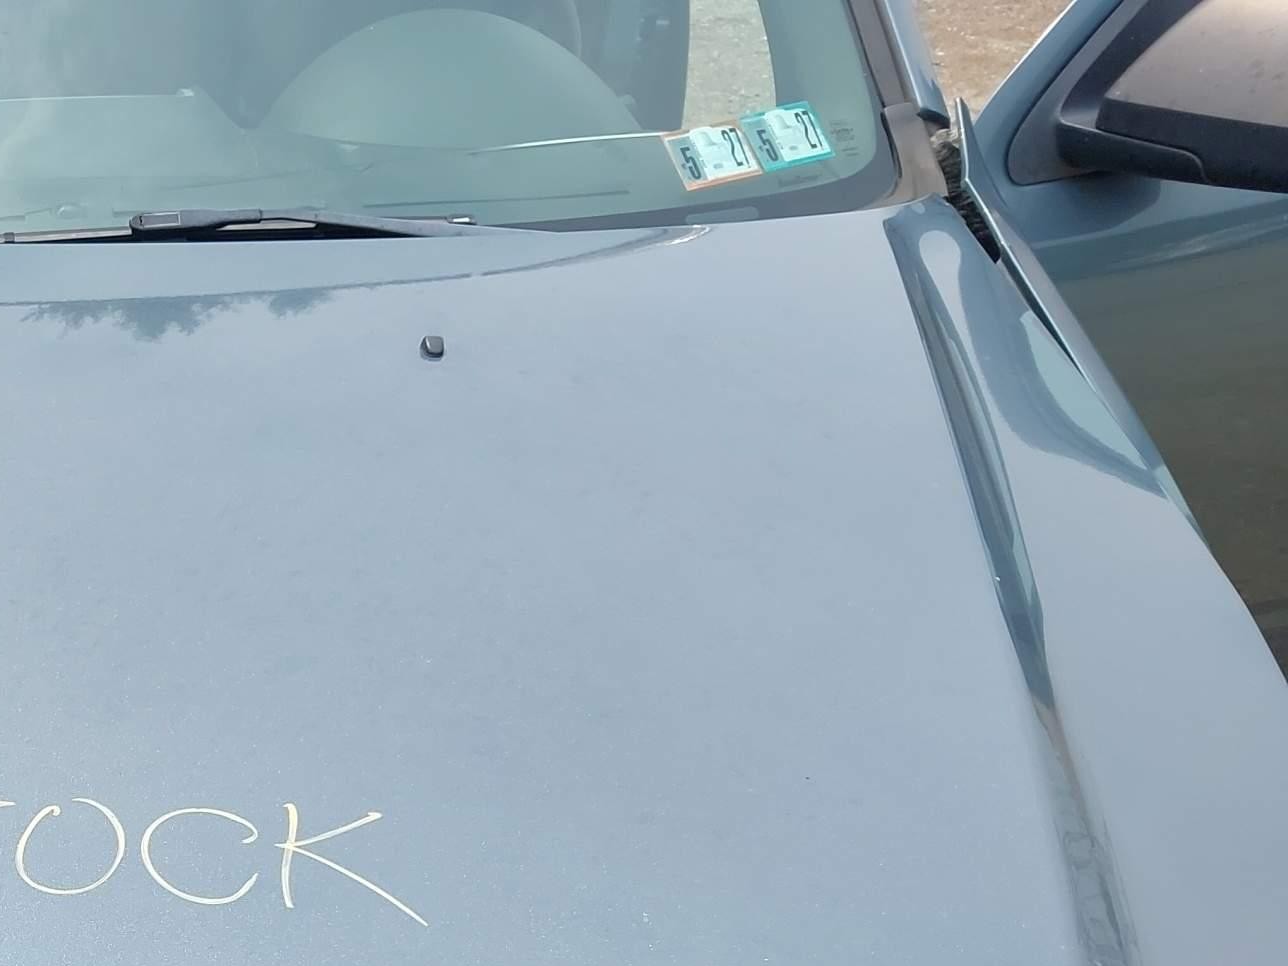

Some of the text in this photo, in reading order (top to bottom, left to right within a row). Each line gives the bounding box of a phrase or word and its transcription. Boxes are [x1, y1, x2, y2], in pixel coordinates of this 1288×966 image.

[680, 127, 750, 179] 5 27
[756, 129, 779, 161] 5
[794, 110, 823, 150] 27
